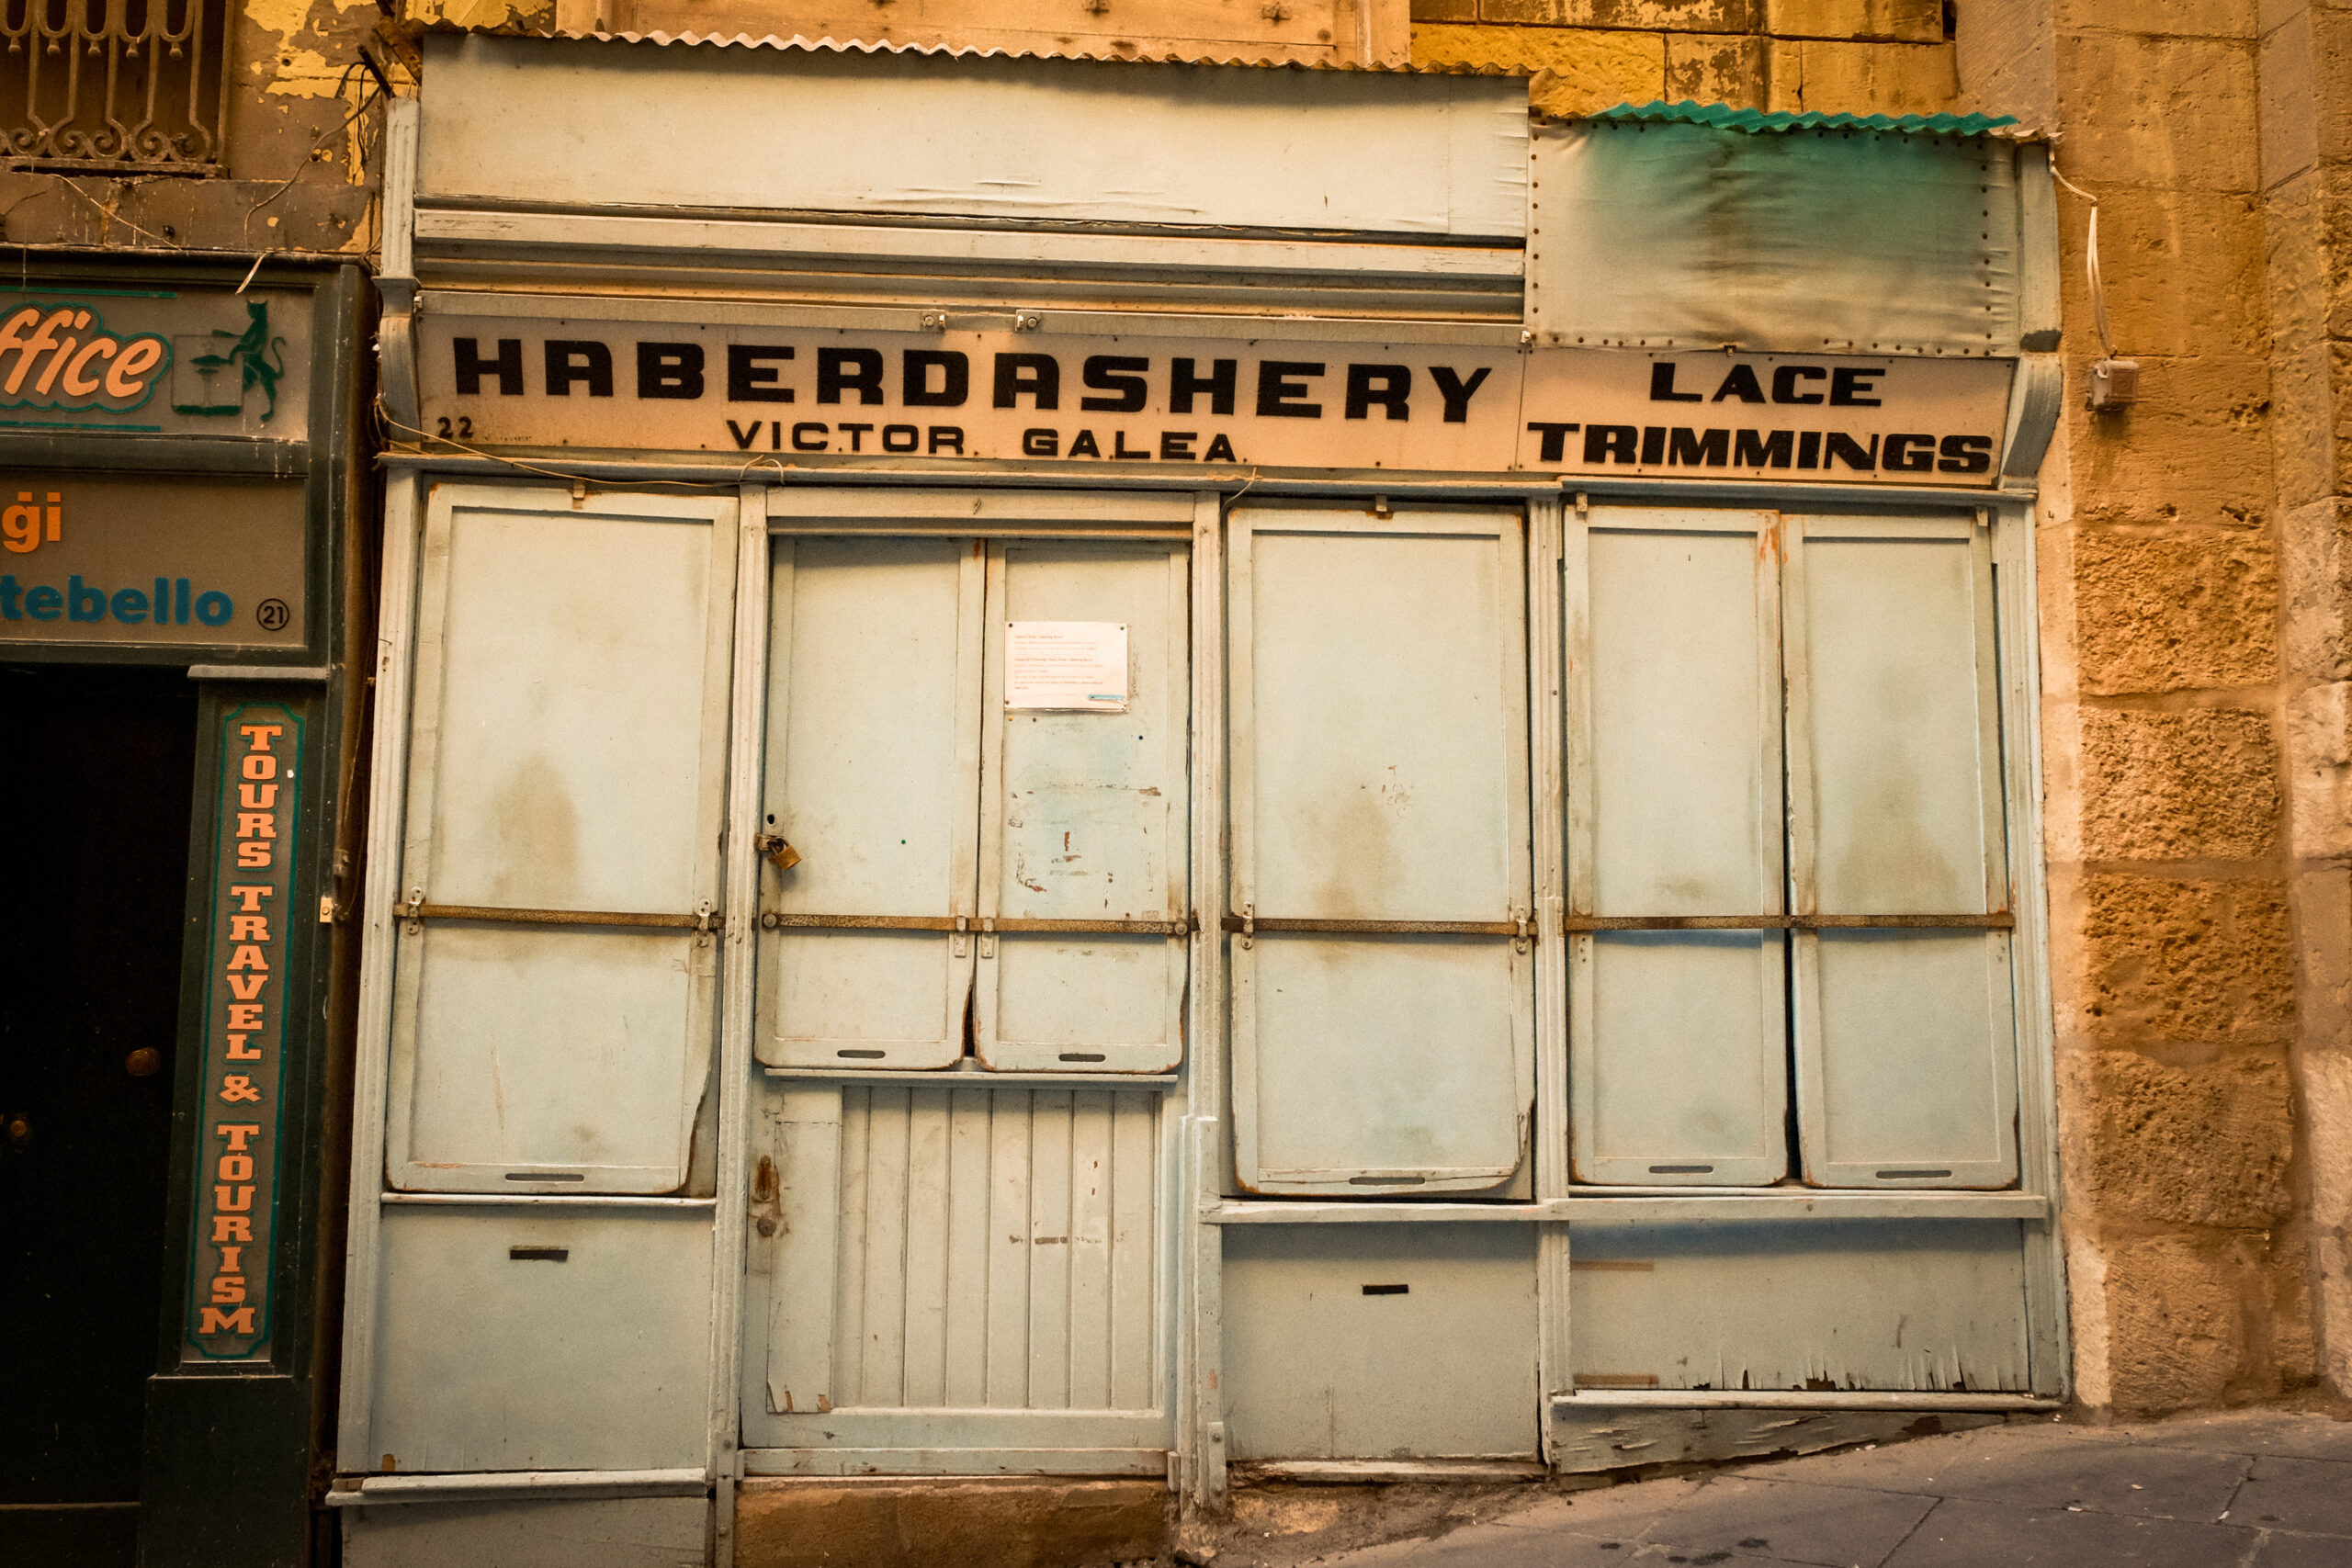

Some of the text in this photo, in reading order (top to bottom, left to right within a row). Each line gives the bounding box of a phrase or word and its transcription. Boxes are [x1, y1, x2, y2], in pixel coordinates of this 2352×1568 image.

[453, 336, 1492, 423] HABERDASHERY
[1650, 362, 1885, 406] LACE
[437, 416, 474, 439] 22
[727, 420, 1237, 462] VICTOR GALEA
[1527, 422, 1993, 473] TRIMMINGS
[0, 574, 234, 626] tebello
[198, 724, 283, 1334] TOURS TRAVEL & TOURISM
